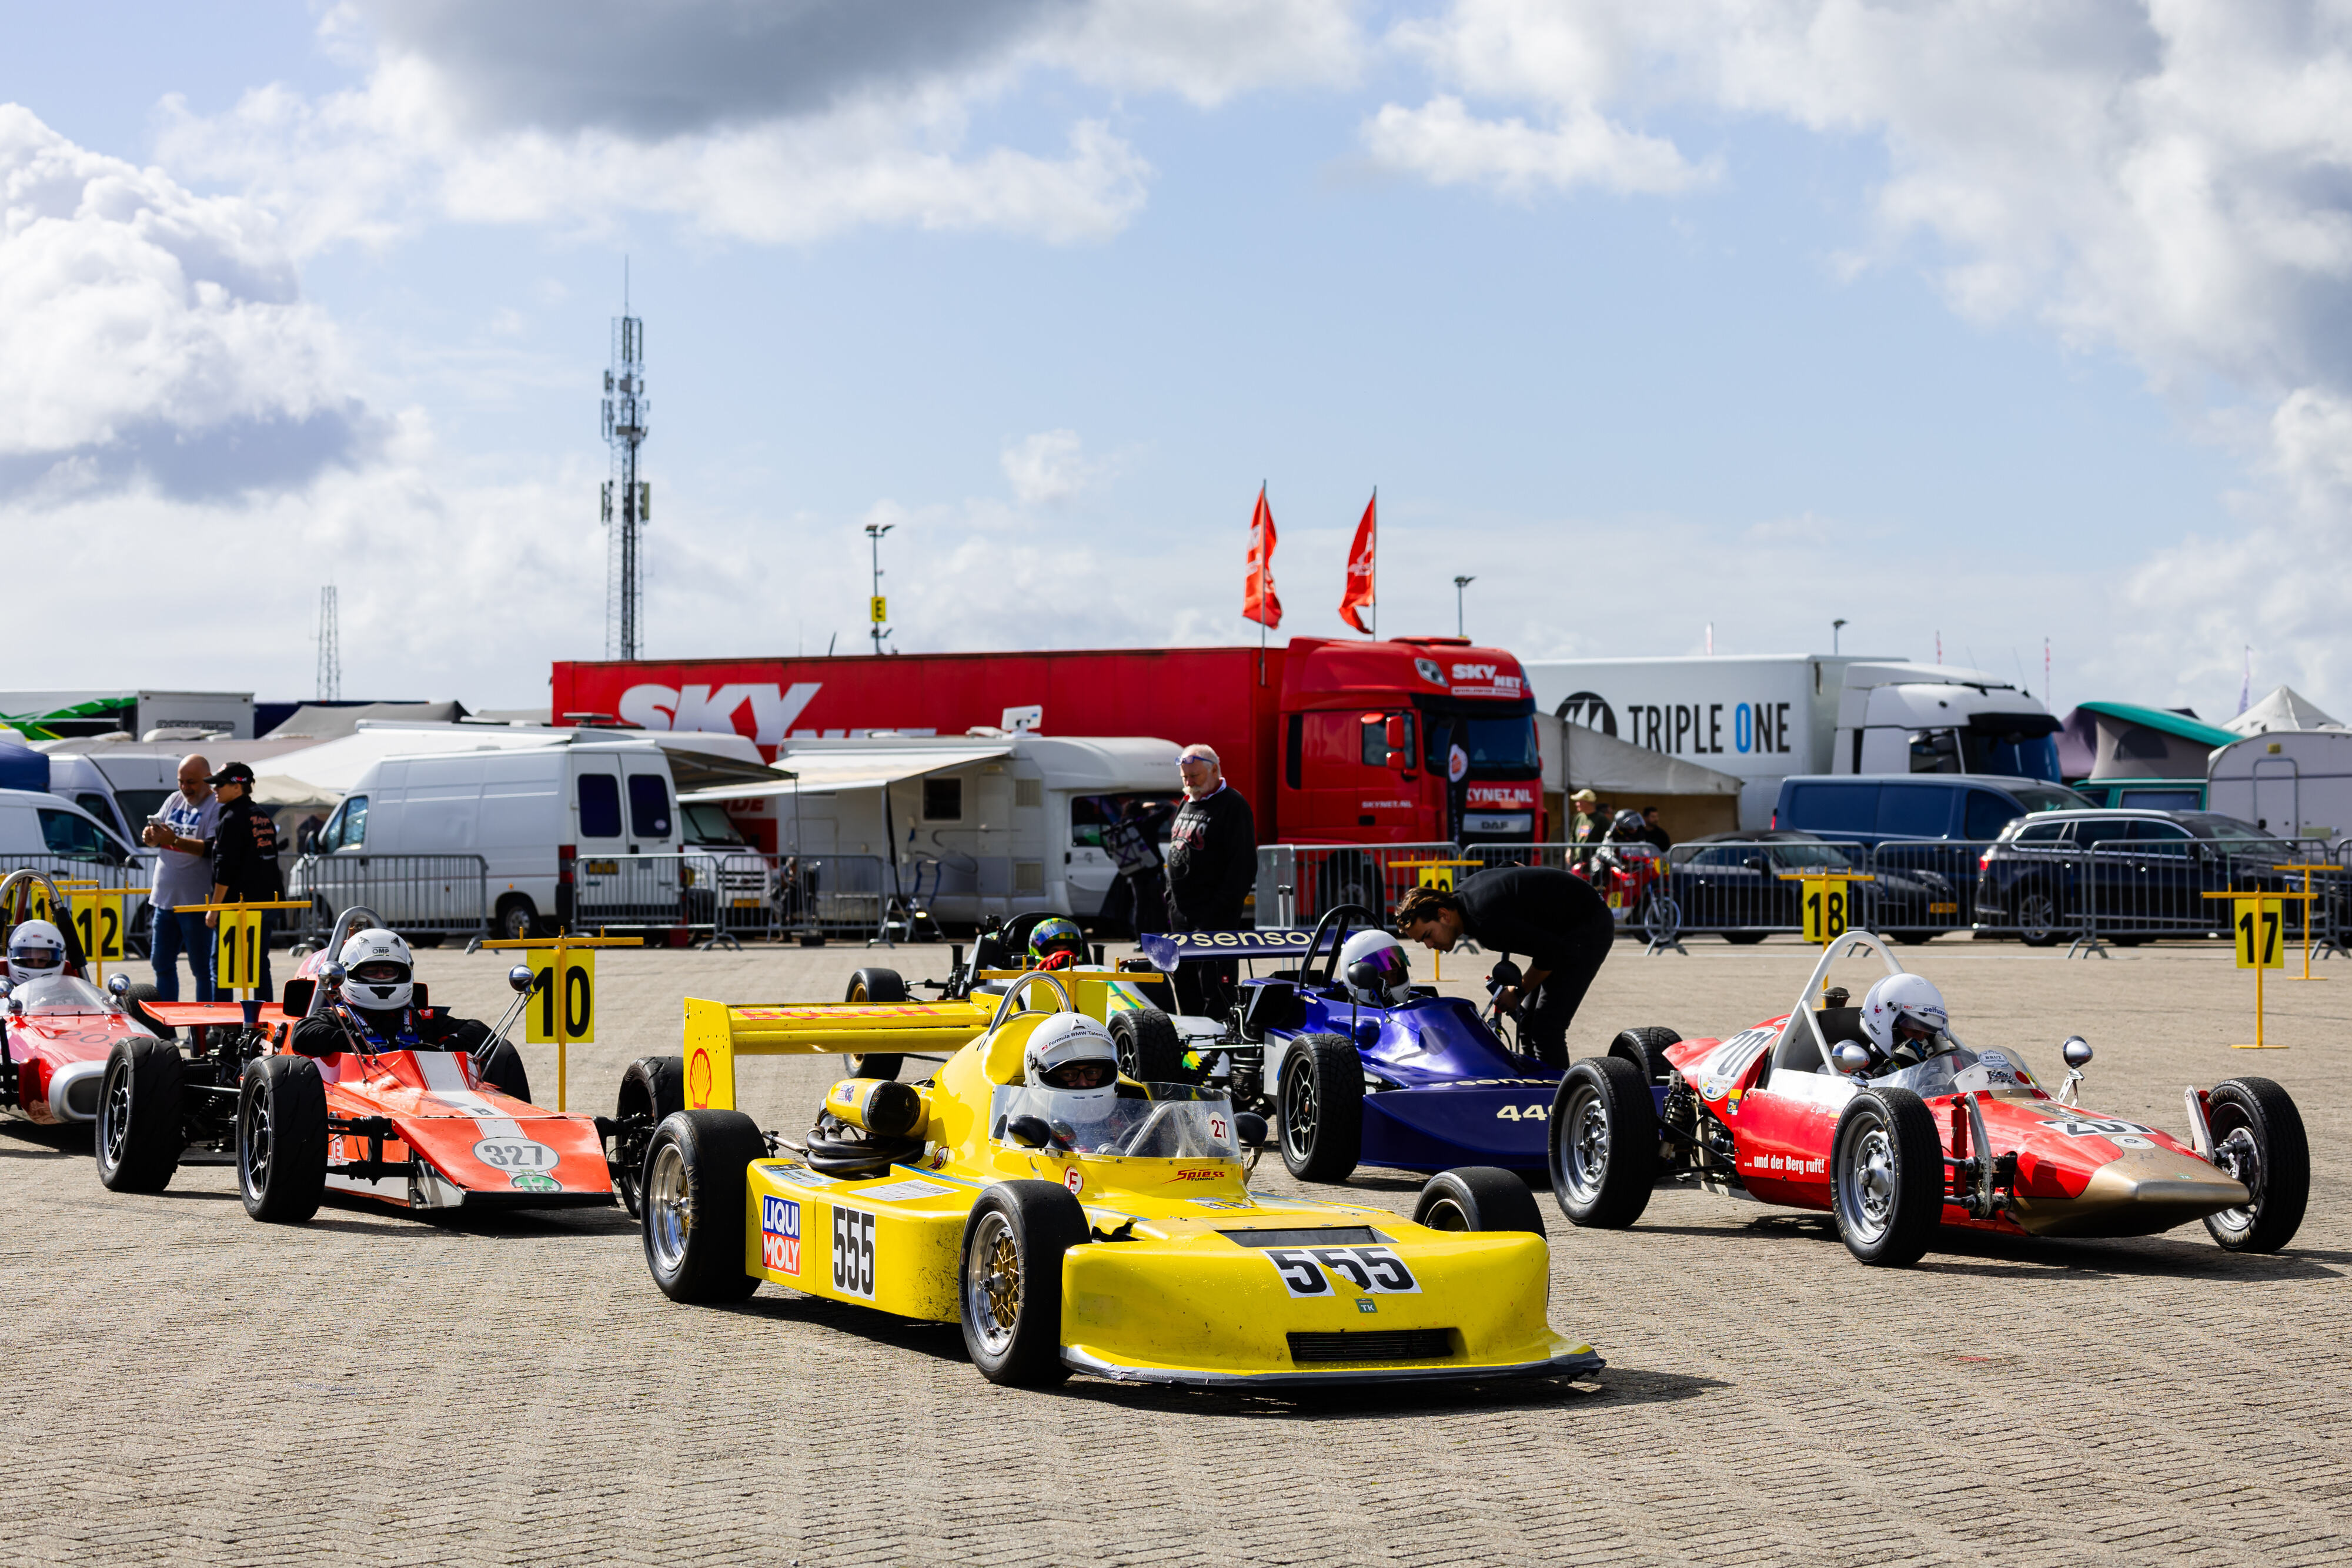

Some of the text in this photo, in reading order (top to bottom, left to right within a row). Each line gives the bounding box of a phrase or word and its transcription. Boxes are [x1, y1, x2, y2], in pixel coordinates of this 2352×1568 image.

[876, 600, 883, 618] E
[1452, 663, 1497, 680] SKY
[1494, 676, 1521, 688] NET
[619, 683, 823, 745] SKY
[1628, 703, 1790, 753] TRIPLE ONE
[1362, 800, 1413, 808] SKYNET.NL
[1481, 820, 1509, 830] DAF
[1808, 892, 1845, 937] 18
[76, 907, 119, 957] 12
[1191, 932, 1316, 947] senso
[2239, 912, 2278, 964] 17
[223, 925, 255, 983] 11
[533, 965, 591, 1038] 10
[736, 1005, 941, 1021] BOSCH
[1048, 1034, 1070, 1047] Formula
[1496, 1104, 1553, 1121] 44
[1211, 1119, 1227, 1139] 27
[2043, 1119, 2153, 1135] 201
[335, 1142, 340, 1159] E
[483, 1145, 543, 1165] 327
[1753, 1154, 1769, 1169] und
[1770, 1154, 1784, 1170] der
[1786, 1155, 1804, 1175] Berg
[1806, 1158, 1825, 1174] ruft!
[1168, 1169, 1225, 1182] Spiess
[764, 1199, 799, 1236] LIQUI
[764, 1234, 800, 1272] MOLY
[833, 1205, 874, 1296] 555
[1265, 1246, 1414, 1294] 555
